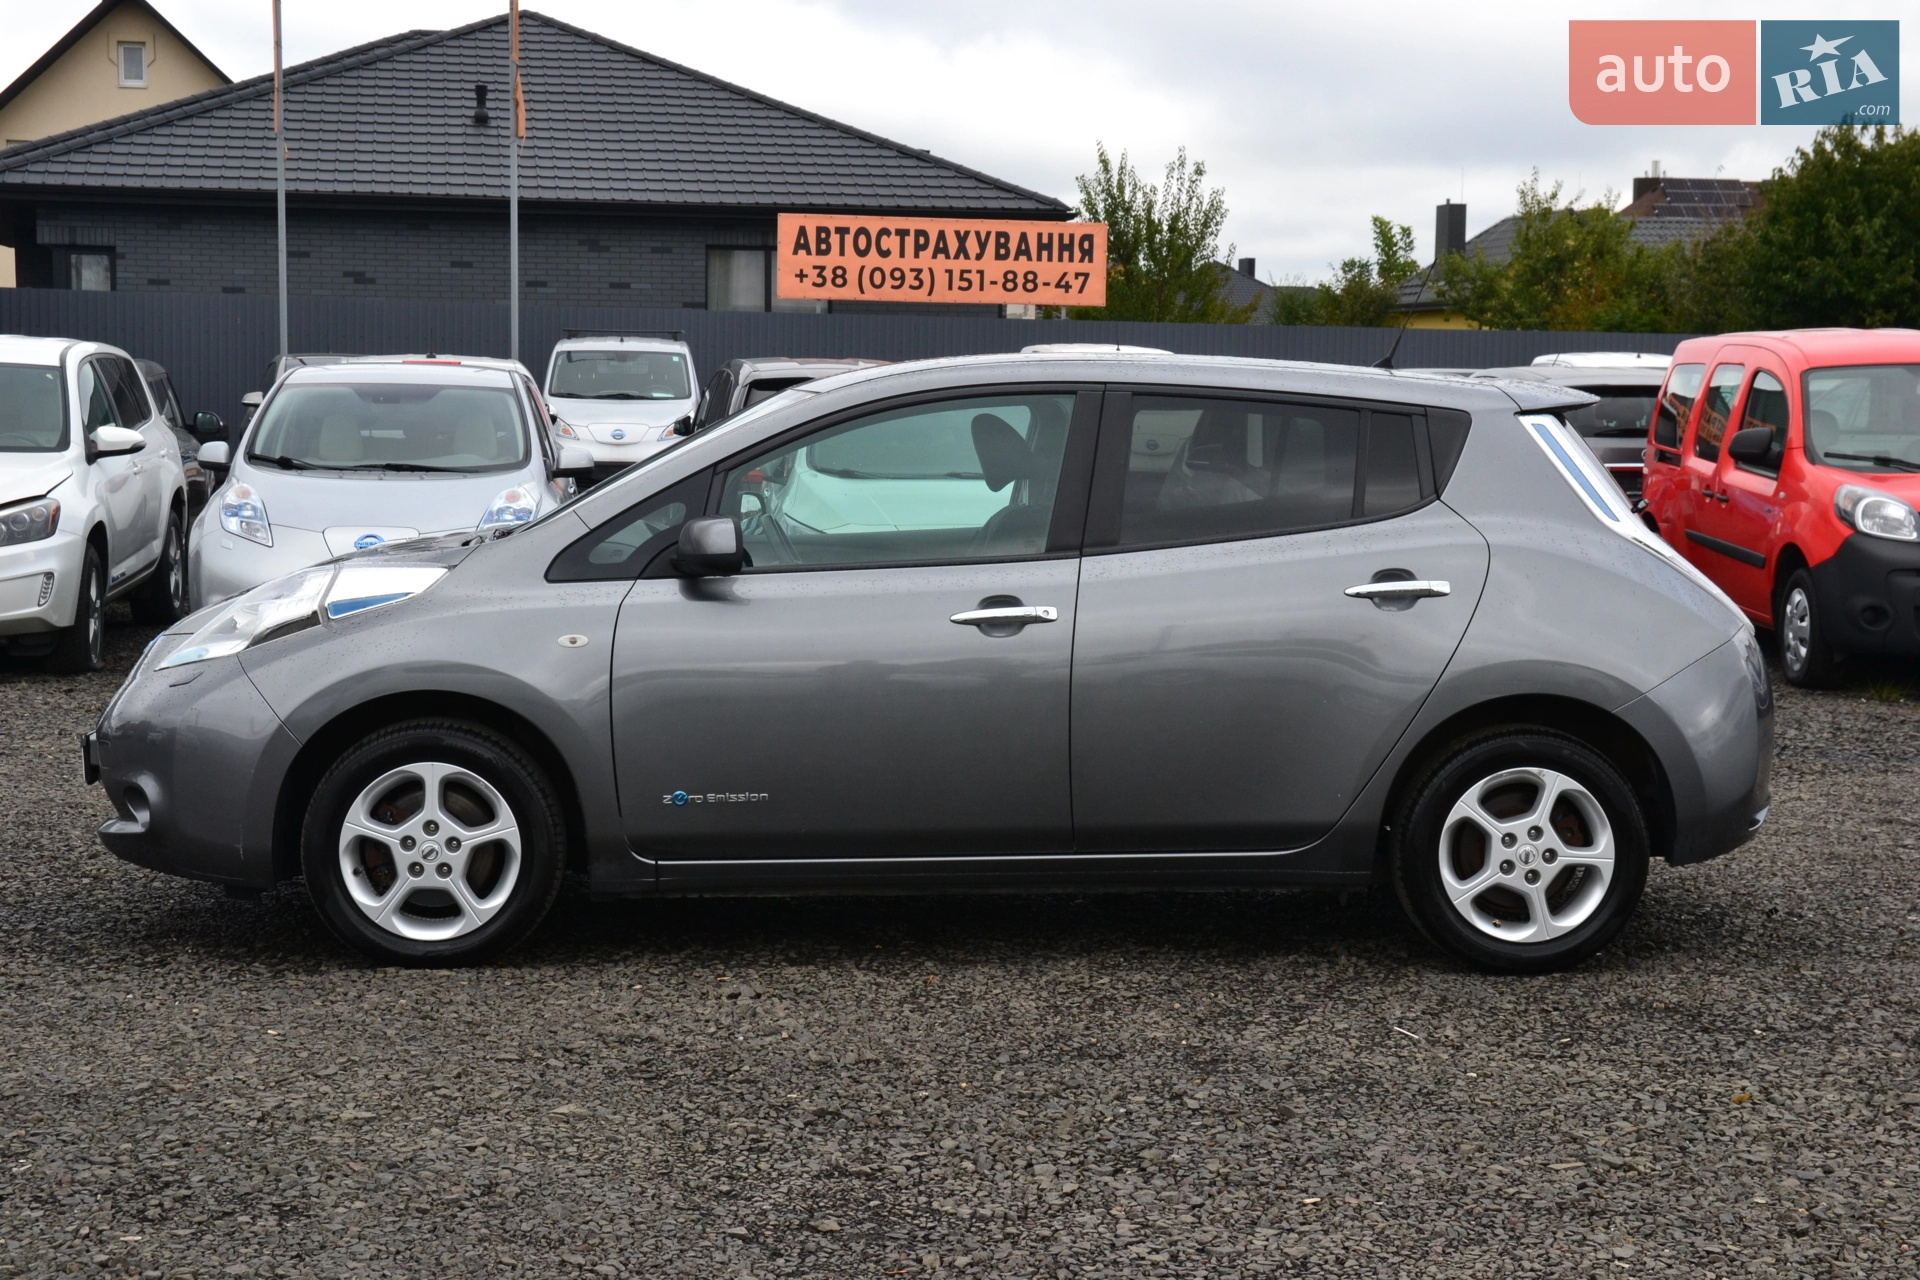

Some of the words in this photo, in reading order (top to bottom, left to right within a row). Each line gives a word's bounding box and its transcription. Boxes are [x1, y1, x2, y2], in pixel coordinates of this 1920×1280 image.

[792, 225, 1095, 263] АВТОСТРАХУВАННЯ
[794, 265, 848, 288] +38
[857, 265, 935, 296] (093)
[945, 268, 1091, 294] 151-88-47
